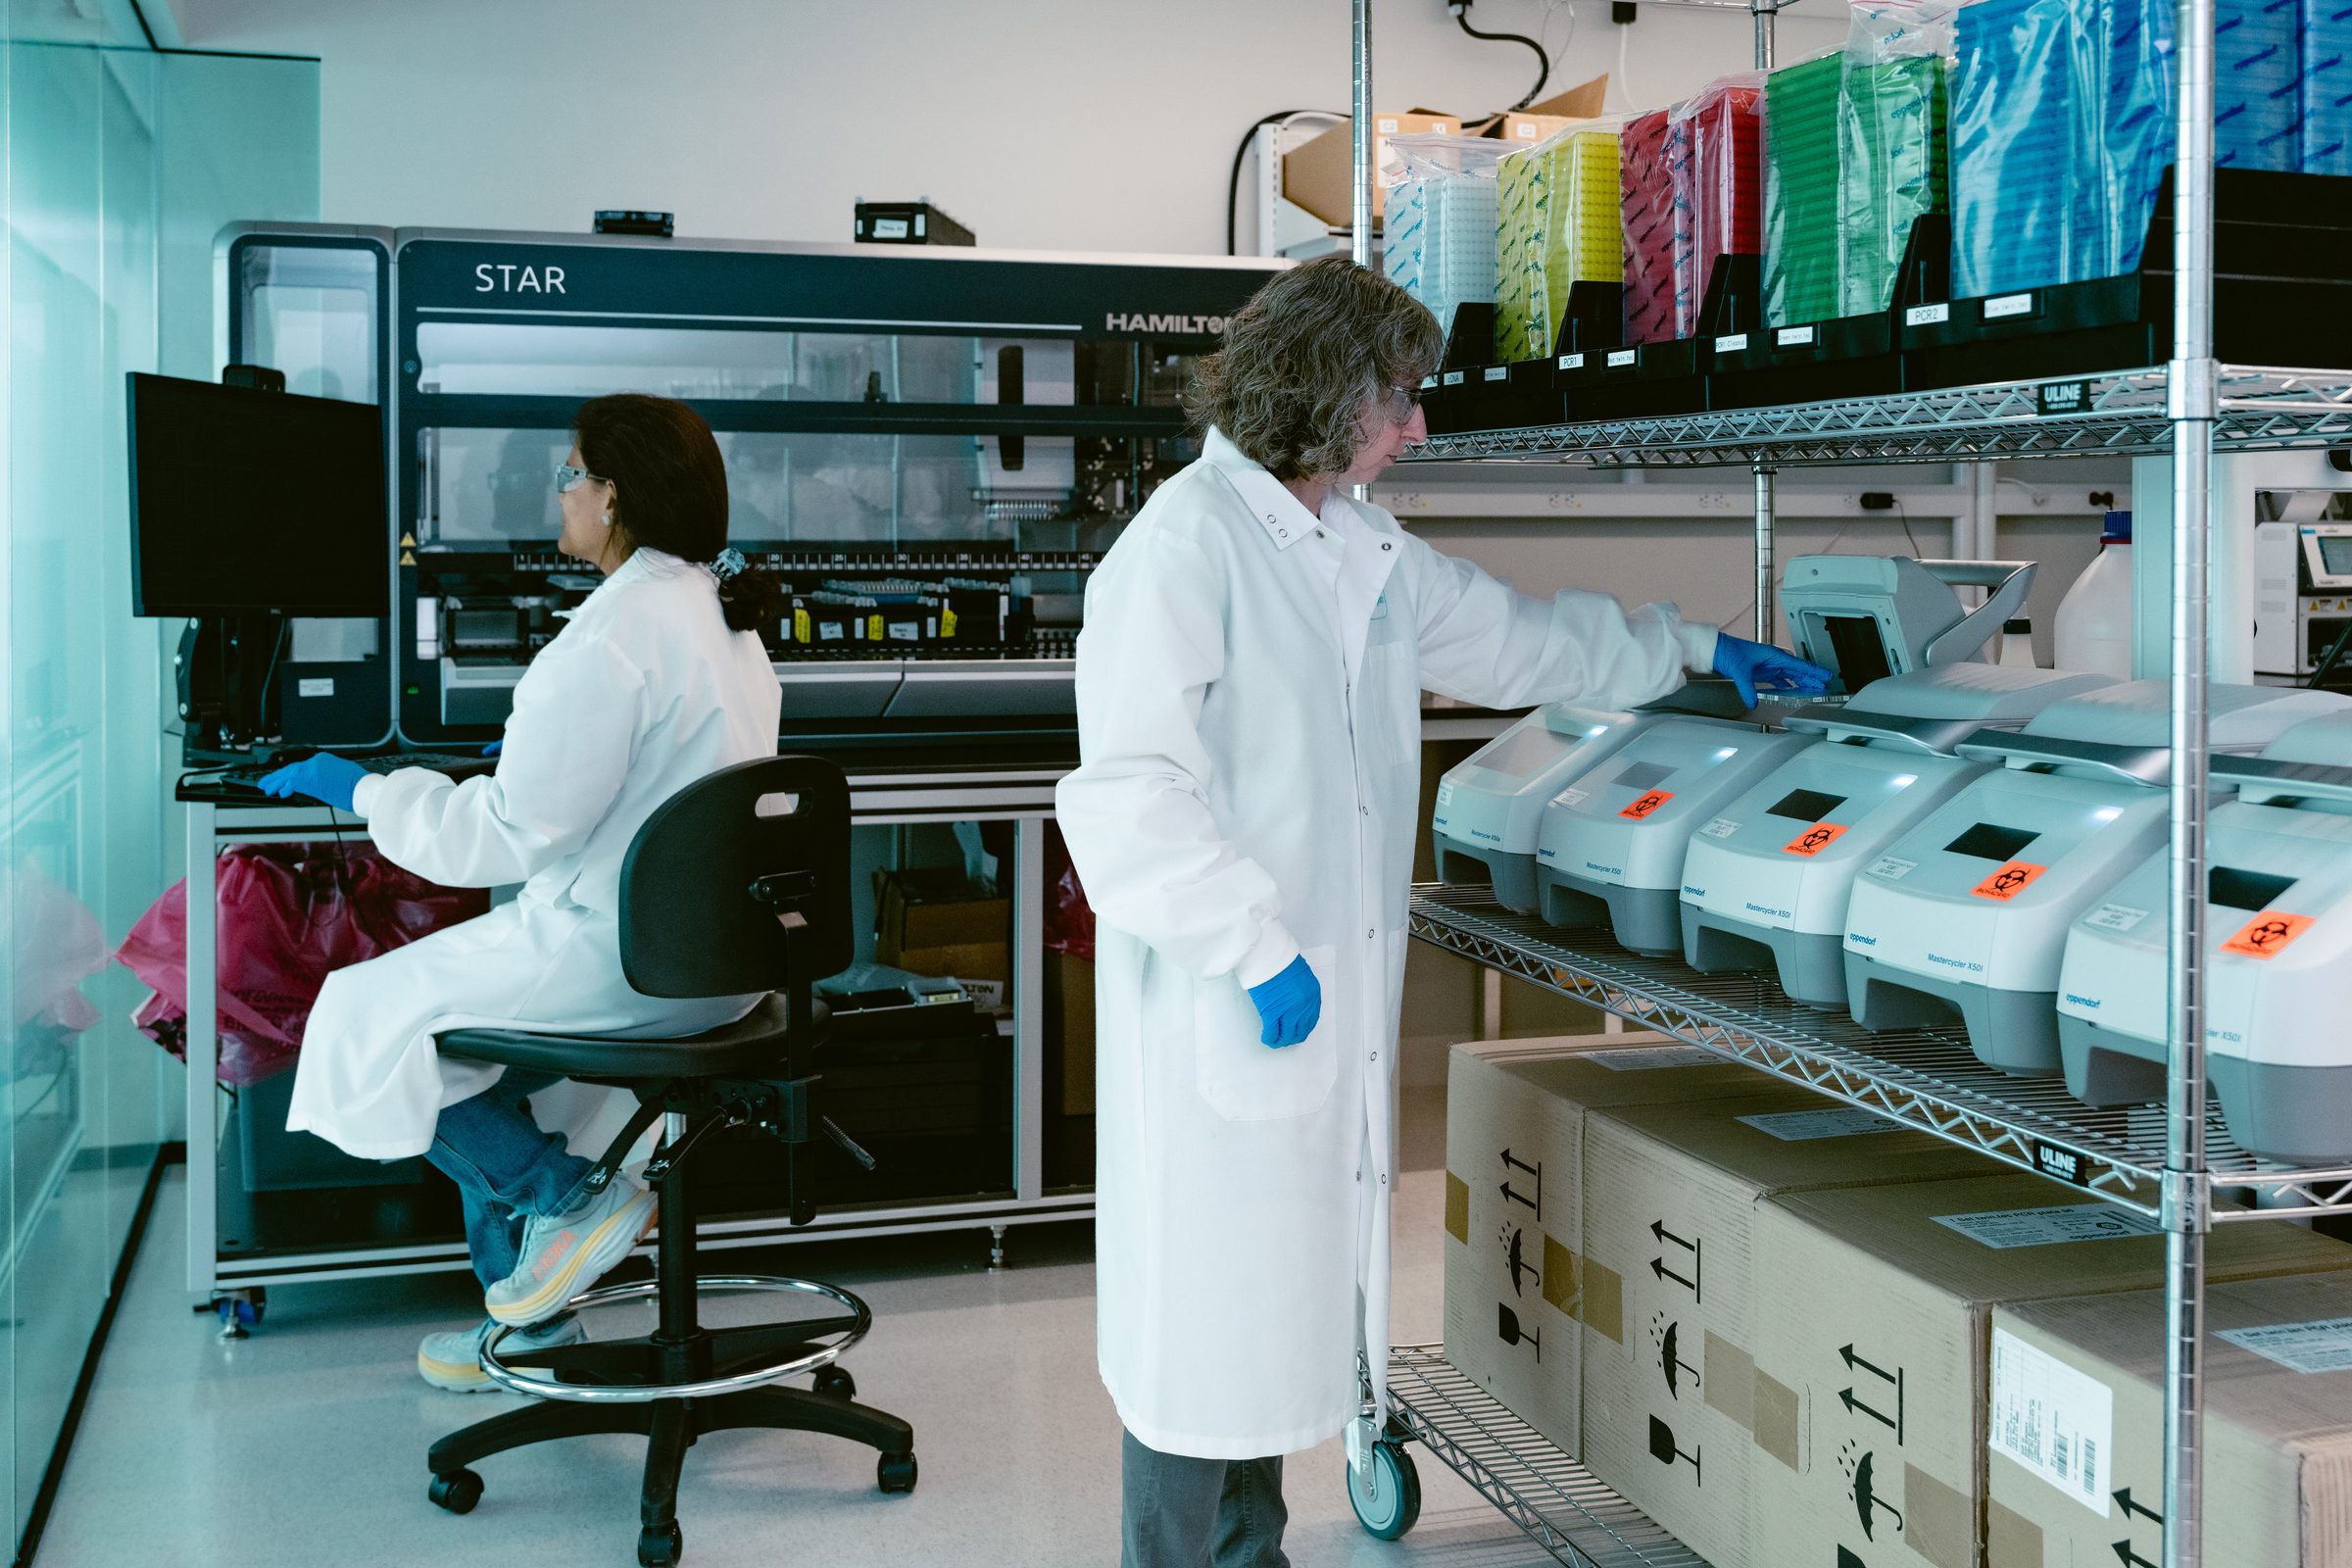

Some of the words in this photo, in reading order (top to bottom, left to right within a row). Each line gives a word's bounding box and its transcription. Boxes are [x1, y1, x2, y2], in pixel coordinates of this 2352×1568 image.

[475, 264, 565, 294] STAR
[1915, 308, 1938, 322] PCR2
[1563, 357, 1577, 368] PCR1
[2044, 383, 2082, 403] ULINE
[1587, 861, 1610, 873] Mastercycler
[1684, 886, 1706, 897] eppendorf
[1745, 902, 1778, 916] Mastercycler
[1849, 932, 1877, 946] eppendorf
[1928, 953, 1967, 969] Mastercycler
[2066, 993, 2101, 1009] eppendorf
[2039, 1146, 2077, 1174] ULINE
[533, 1229, 578, 1282] HOKA
